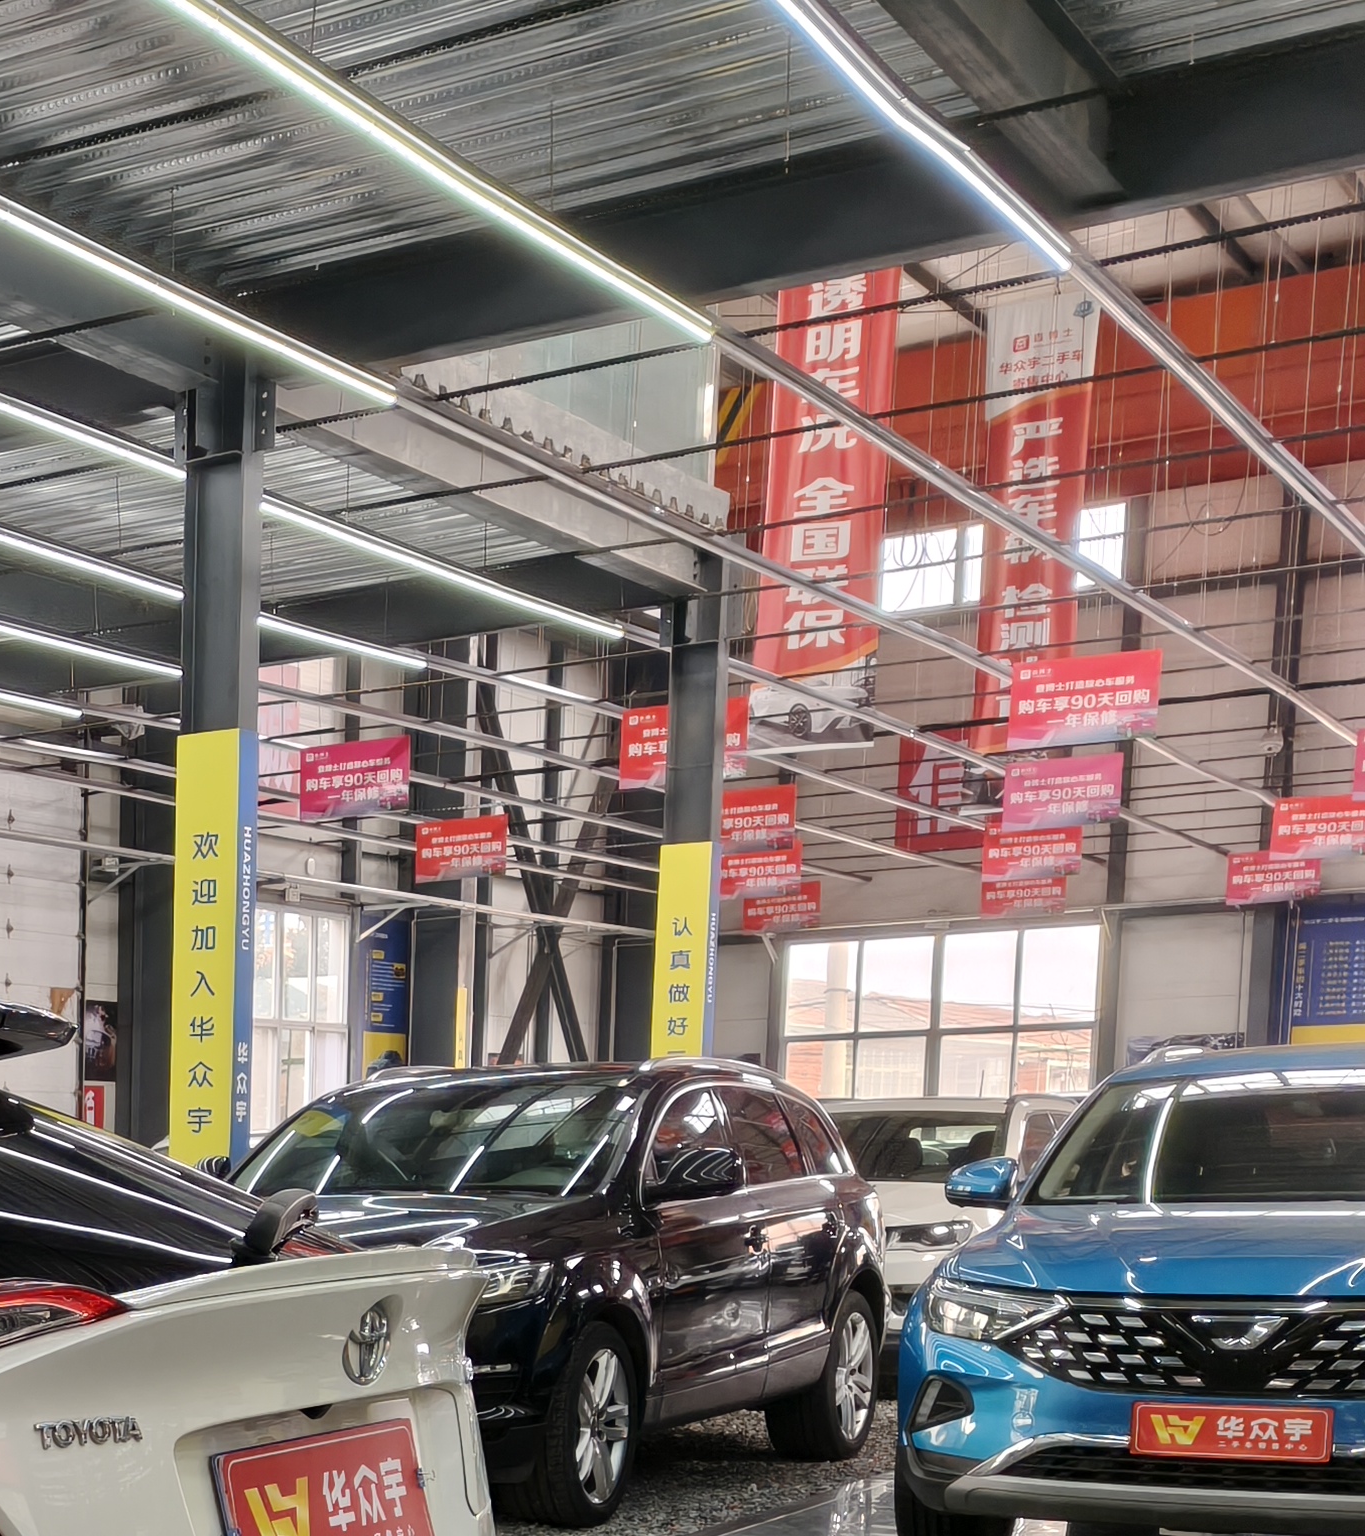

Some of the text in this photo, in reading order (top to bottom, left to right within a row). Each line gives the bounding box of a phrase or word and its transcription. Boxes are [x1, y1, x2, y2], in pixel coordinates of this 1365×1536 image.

[1018, 688, 1151, 715] 购车享90天回购
[1046, 709, 1118, 728] 一年保修
[305, 768, 403, 792] 购车享90天回购
[327, 786, 380, 803] 一年保修
[1010, 784, 1115, 805] 购车享90天回购
[1032, 800, 1089, 815] 一年保修
[421, 841, 502, 859] 购车享90天回购
[240, 825, 253, 951] HUAZHONGYU
[186, 831, 219, 1134] 欢迎加入华众宇
[235, 1041, 249, 1123] 华众宇
[33, 1415, 144, 1450] TOYOTA
[1216, 1415, 1314, 1442] 华众宇
[322, 1457, 408, 1532] 华众宇
